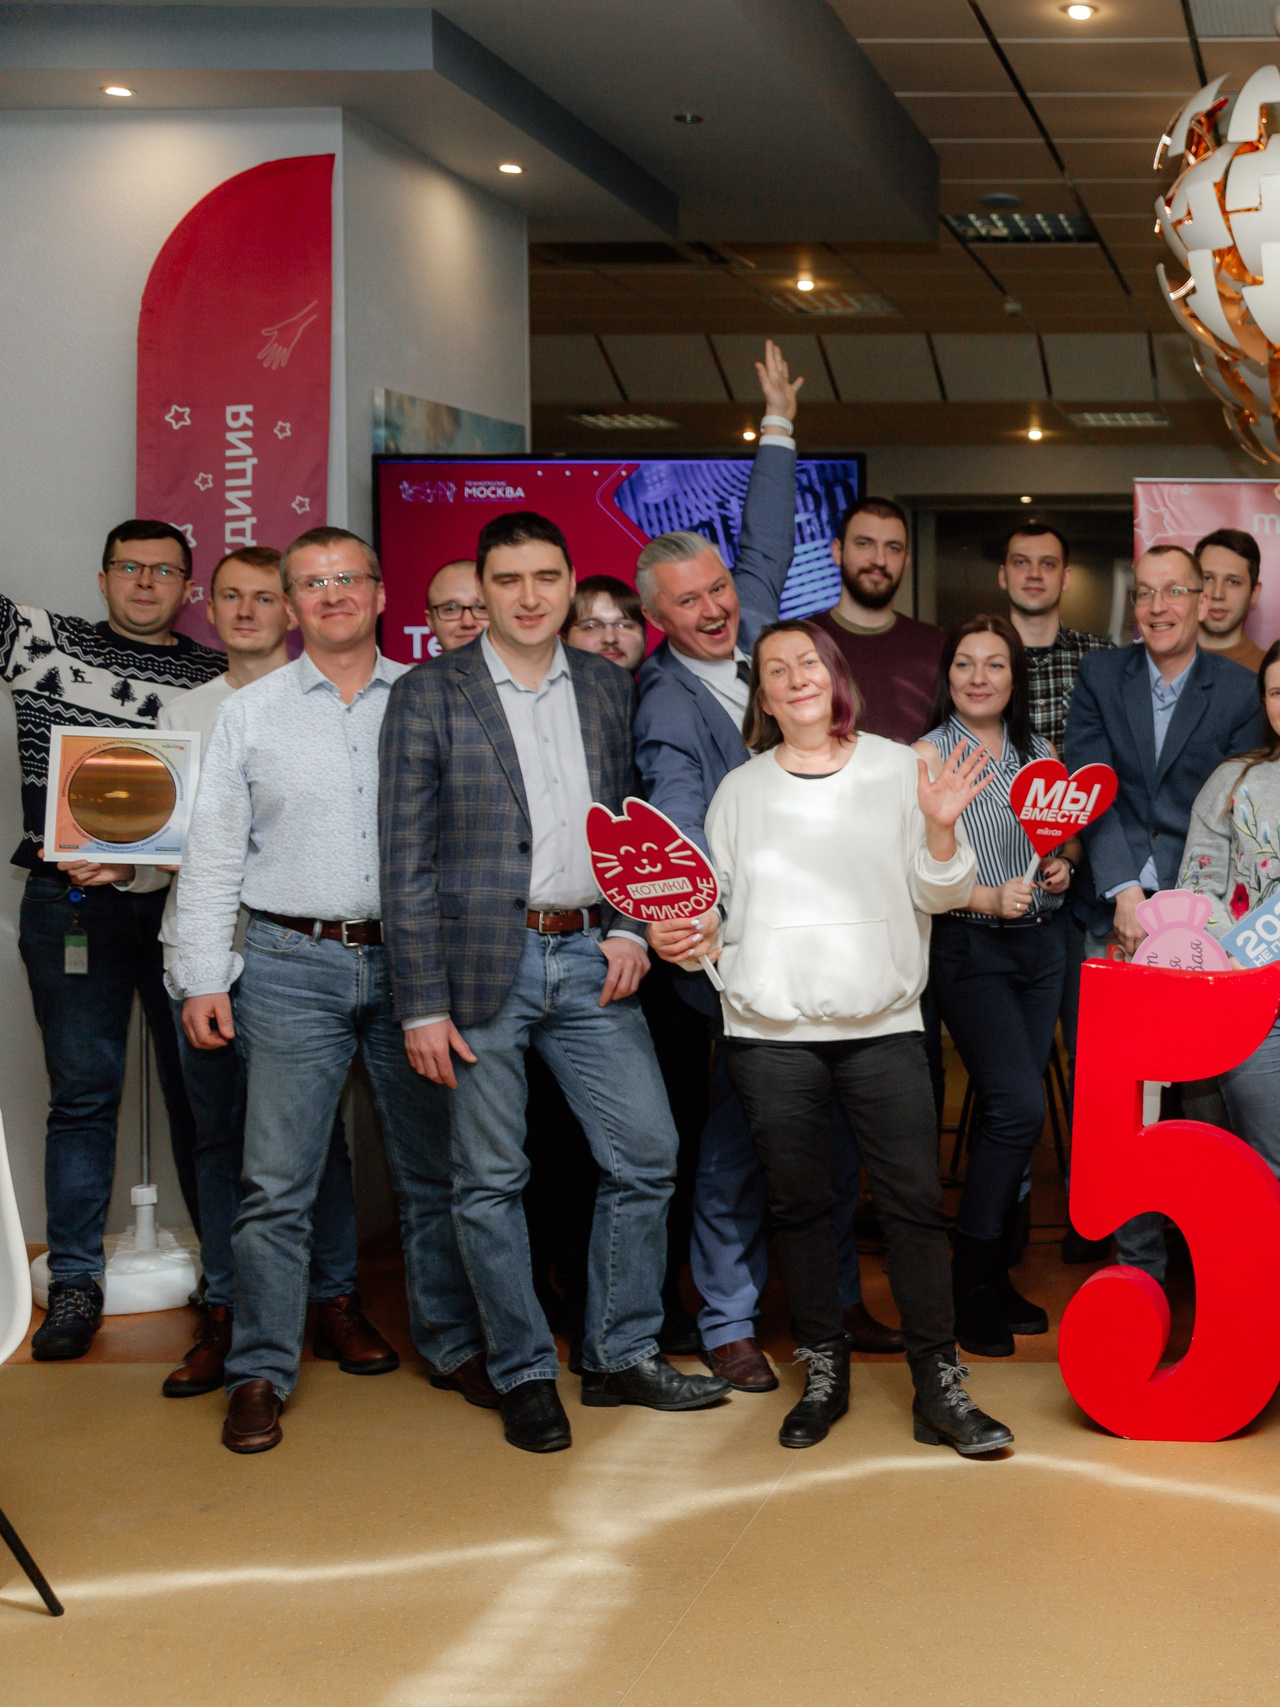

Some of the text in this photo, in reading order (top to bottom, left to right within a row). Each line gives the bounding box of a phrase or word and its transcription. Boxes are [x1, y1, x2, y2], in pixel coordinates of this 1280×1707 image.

[225, 404, 258, 555] ДИЦИЯ
[464, 486, 526, 499] МОСКВА
[1024, 777, 1101, 812] МЫ
[1020, 806, 1091, 825] ВМЕСТЕ
[1036, 827, 1062, 836] mikron
[629, 879, 689, 896] КОТИКИ
[606, 876, 715, 919] НА МИКРОНЕ
[1253, 949, 1274, 967] НЕ
